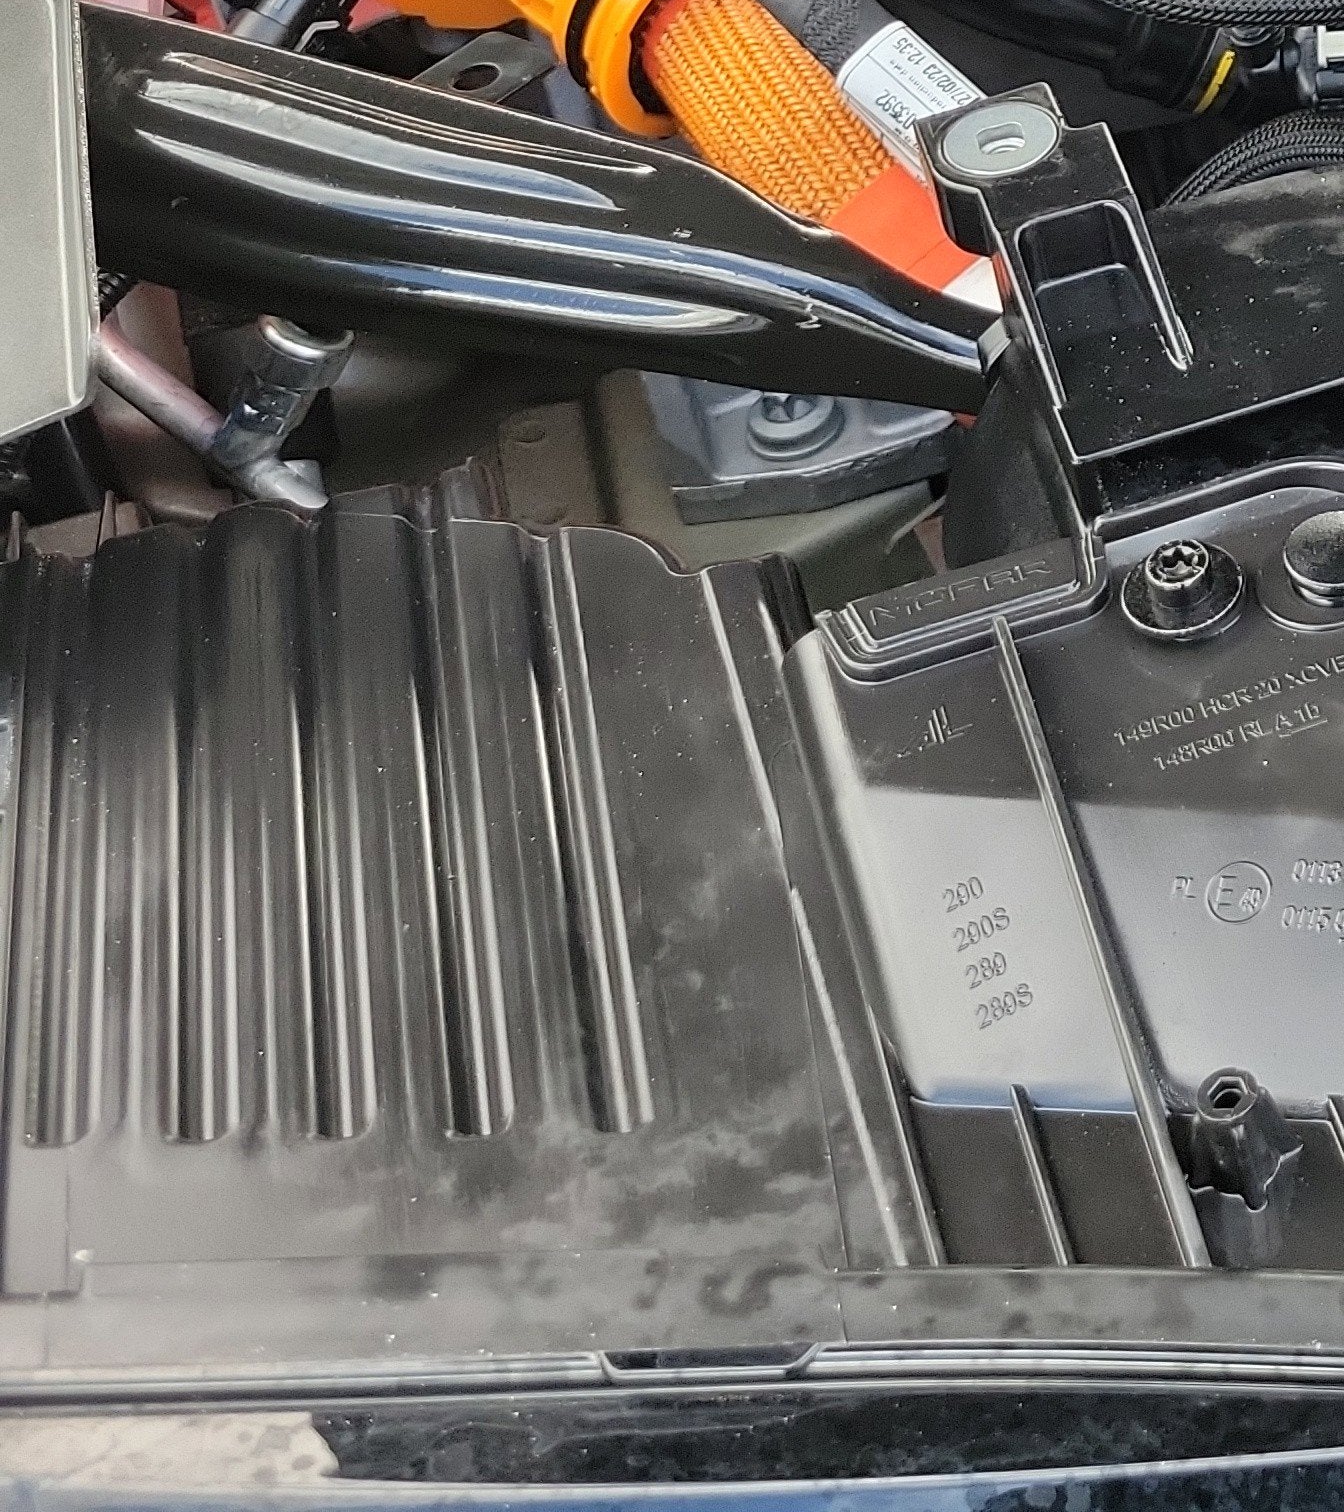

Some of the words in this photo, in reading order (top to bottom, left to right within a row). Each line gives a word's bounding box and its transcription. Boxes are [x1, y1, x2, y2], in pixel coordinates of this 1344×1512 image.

[892, 37, 928, 66] 12:35
[909, 74, 949, 109] roduction
[1112, 705, 1196, 747] 149R00
[1198, 687, 1254, 719] HCR
[1253, 677, 1283, 700] 20
[1152, 728, 1236, 771] 148R00
[1237, 718, 1272, 743] RL
[1275, 711, 1294, 731] A
[1291, 858, 1343, 886] 0113
[942, 876, 984, 913] 290
[952, 907, 1011, 953] 290S
[965, 952, 1007, 989] 289
[975, 982, 1034, 1030] 289S
